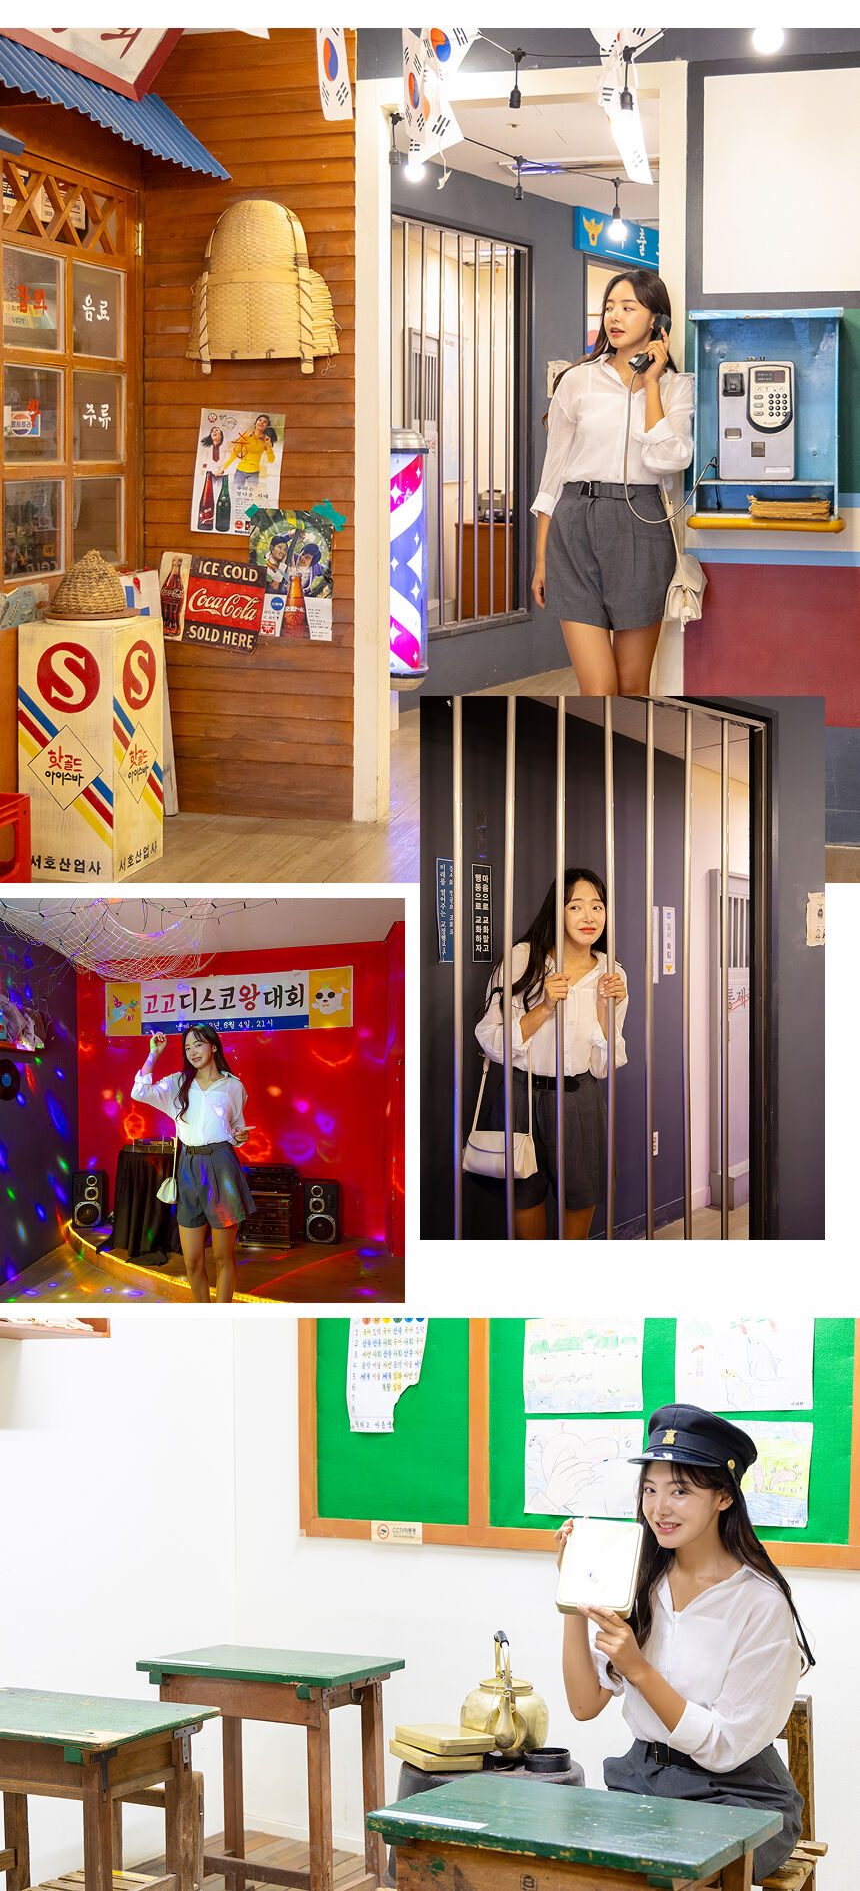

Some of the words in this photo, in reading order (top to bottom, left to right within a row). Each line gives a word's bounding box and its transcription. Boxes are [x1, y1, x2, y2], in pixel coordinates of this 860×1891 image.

[82, 294, 110, 322] 음료
[82, 403, 112, 430] 주류
[198, 560, 220, 576] ICE
[223, 564, 258, 582] COLD
[188, 625, 220, 642] SOLD
[222, 630, 255, 649] HERE
[51, 649, 86, 705] S
[130, 649, 150, 701] S
[48, 746, 82, 771] 핫골드
[129, 744, 148, 769] 핫골드
[45, 770, 84, 787] 아이스바
[128, 765, 149, 786] 아이스바
[31, 855, 102, 875] 서호산업사
[118, 840, 158, 873] 서호산업사
[474, 873, 482, 910] 행동으로
[256, 1018, 273, 1028] 21시
